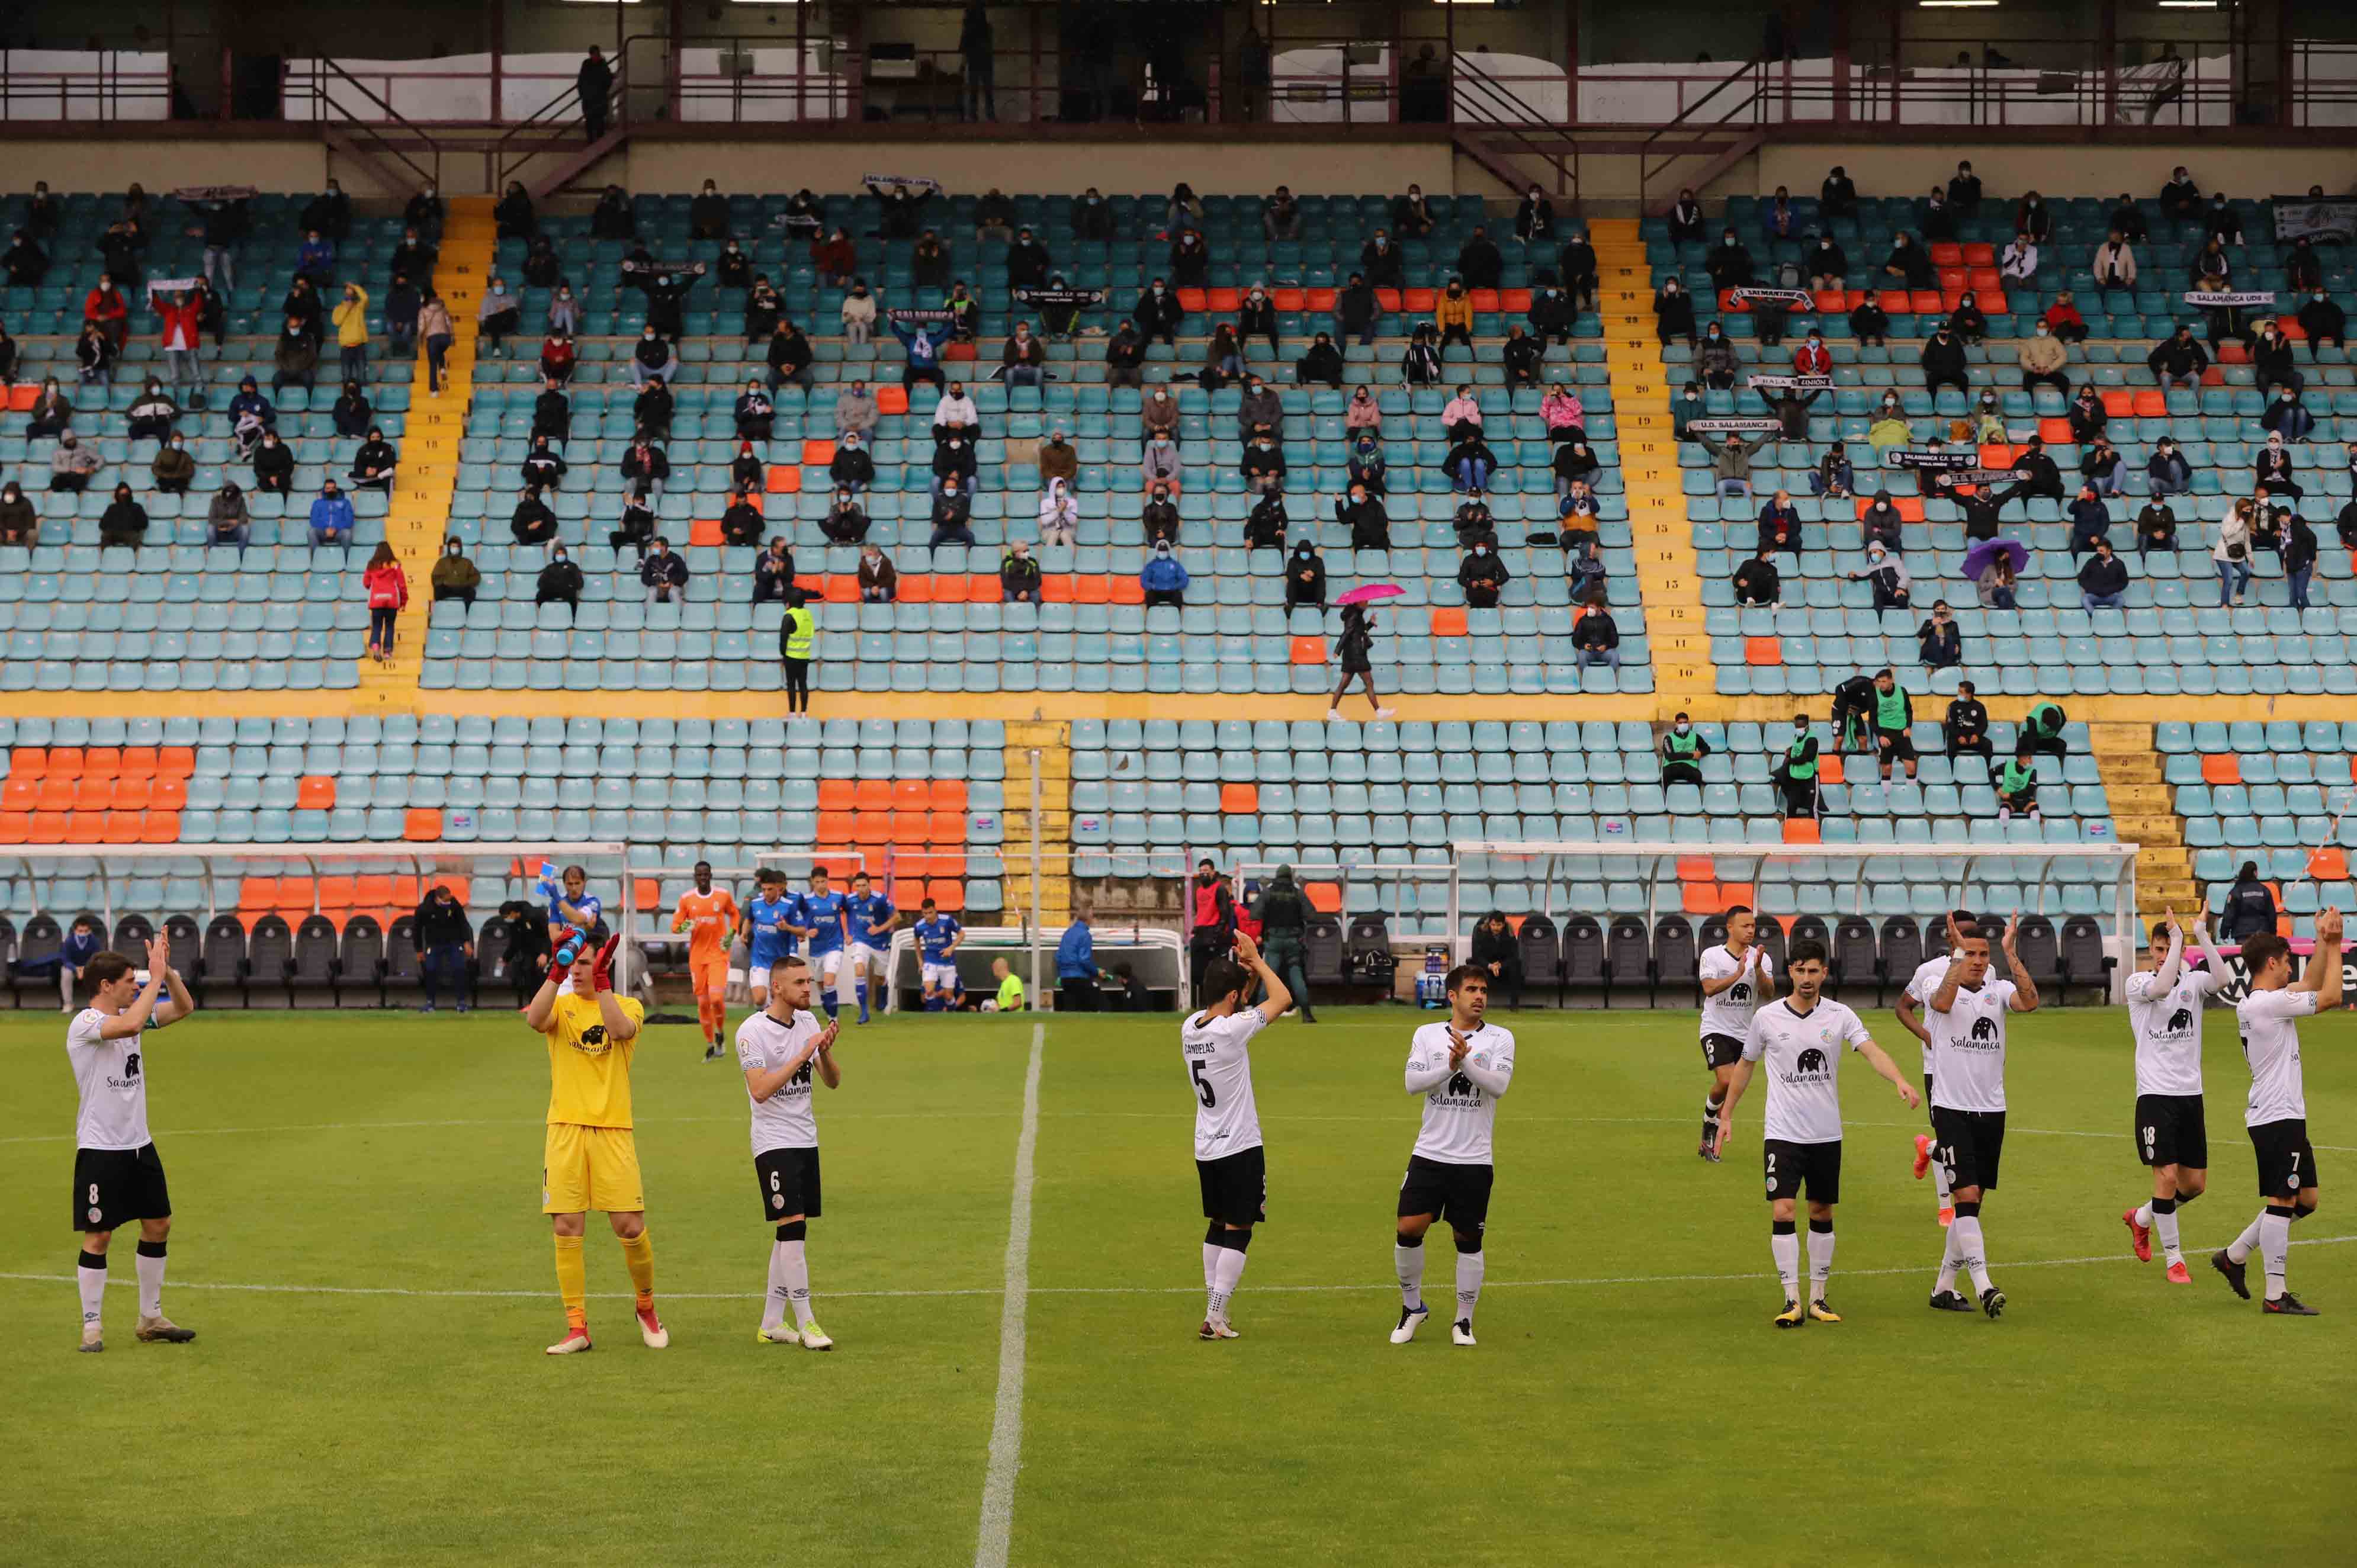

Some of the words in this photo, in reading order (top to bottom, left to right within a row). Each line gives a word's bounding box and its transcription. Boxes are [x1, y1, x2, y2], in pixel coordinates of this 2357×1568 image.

[2197, 294, 2244, 303] SALAMANCA
[1633, 362, 1643, 371] 21
[1636, 385, 1649, 393] 20
[428, 415, 440, 423] 19
[1638, 417, 1650, 425] 19
[1646, 471, 1658, 479] 17
[404, 548, 415, 556] 14
[1671, 609, 1683, 618] 12
[1676, 639, 1685, 648] 11
[1680, 669, 1692, 677] 10
[1685, 697, 1691, 705] 9
[2134, 789, 2139, 798] 7
[2142, 821, 2148, 830] 6
[1950, 1036, 2000, 1050] Salamanca
[1184, 1042, 1215, 1055] CANDELAS
[1780, 1071, 1832, 1084] Salamanca
[1192, 1059, 1216, 1108] 5
[1430, 1093, 1482, 1108] Salamanca
[2143, 1126, 2155, 1145] 18
[1940, 1146, 1955, 1167] 21
[1767, 1153, 1775, 1173] 2
[2291, 1152, 2300, 1172] 7
[770, 1171, 780, 1191] 6
[89, 1183, 98, 1204] 8
